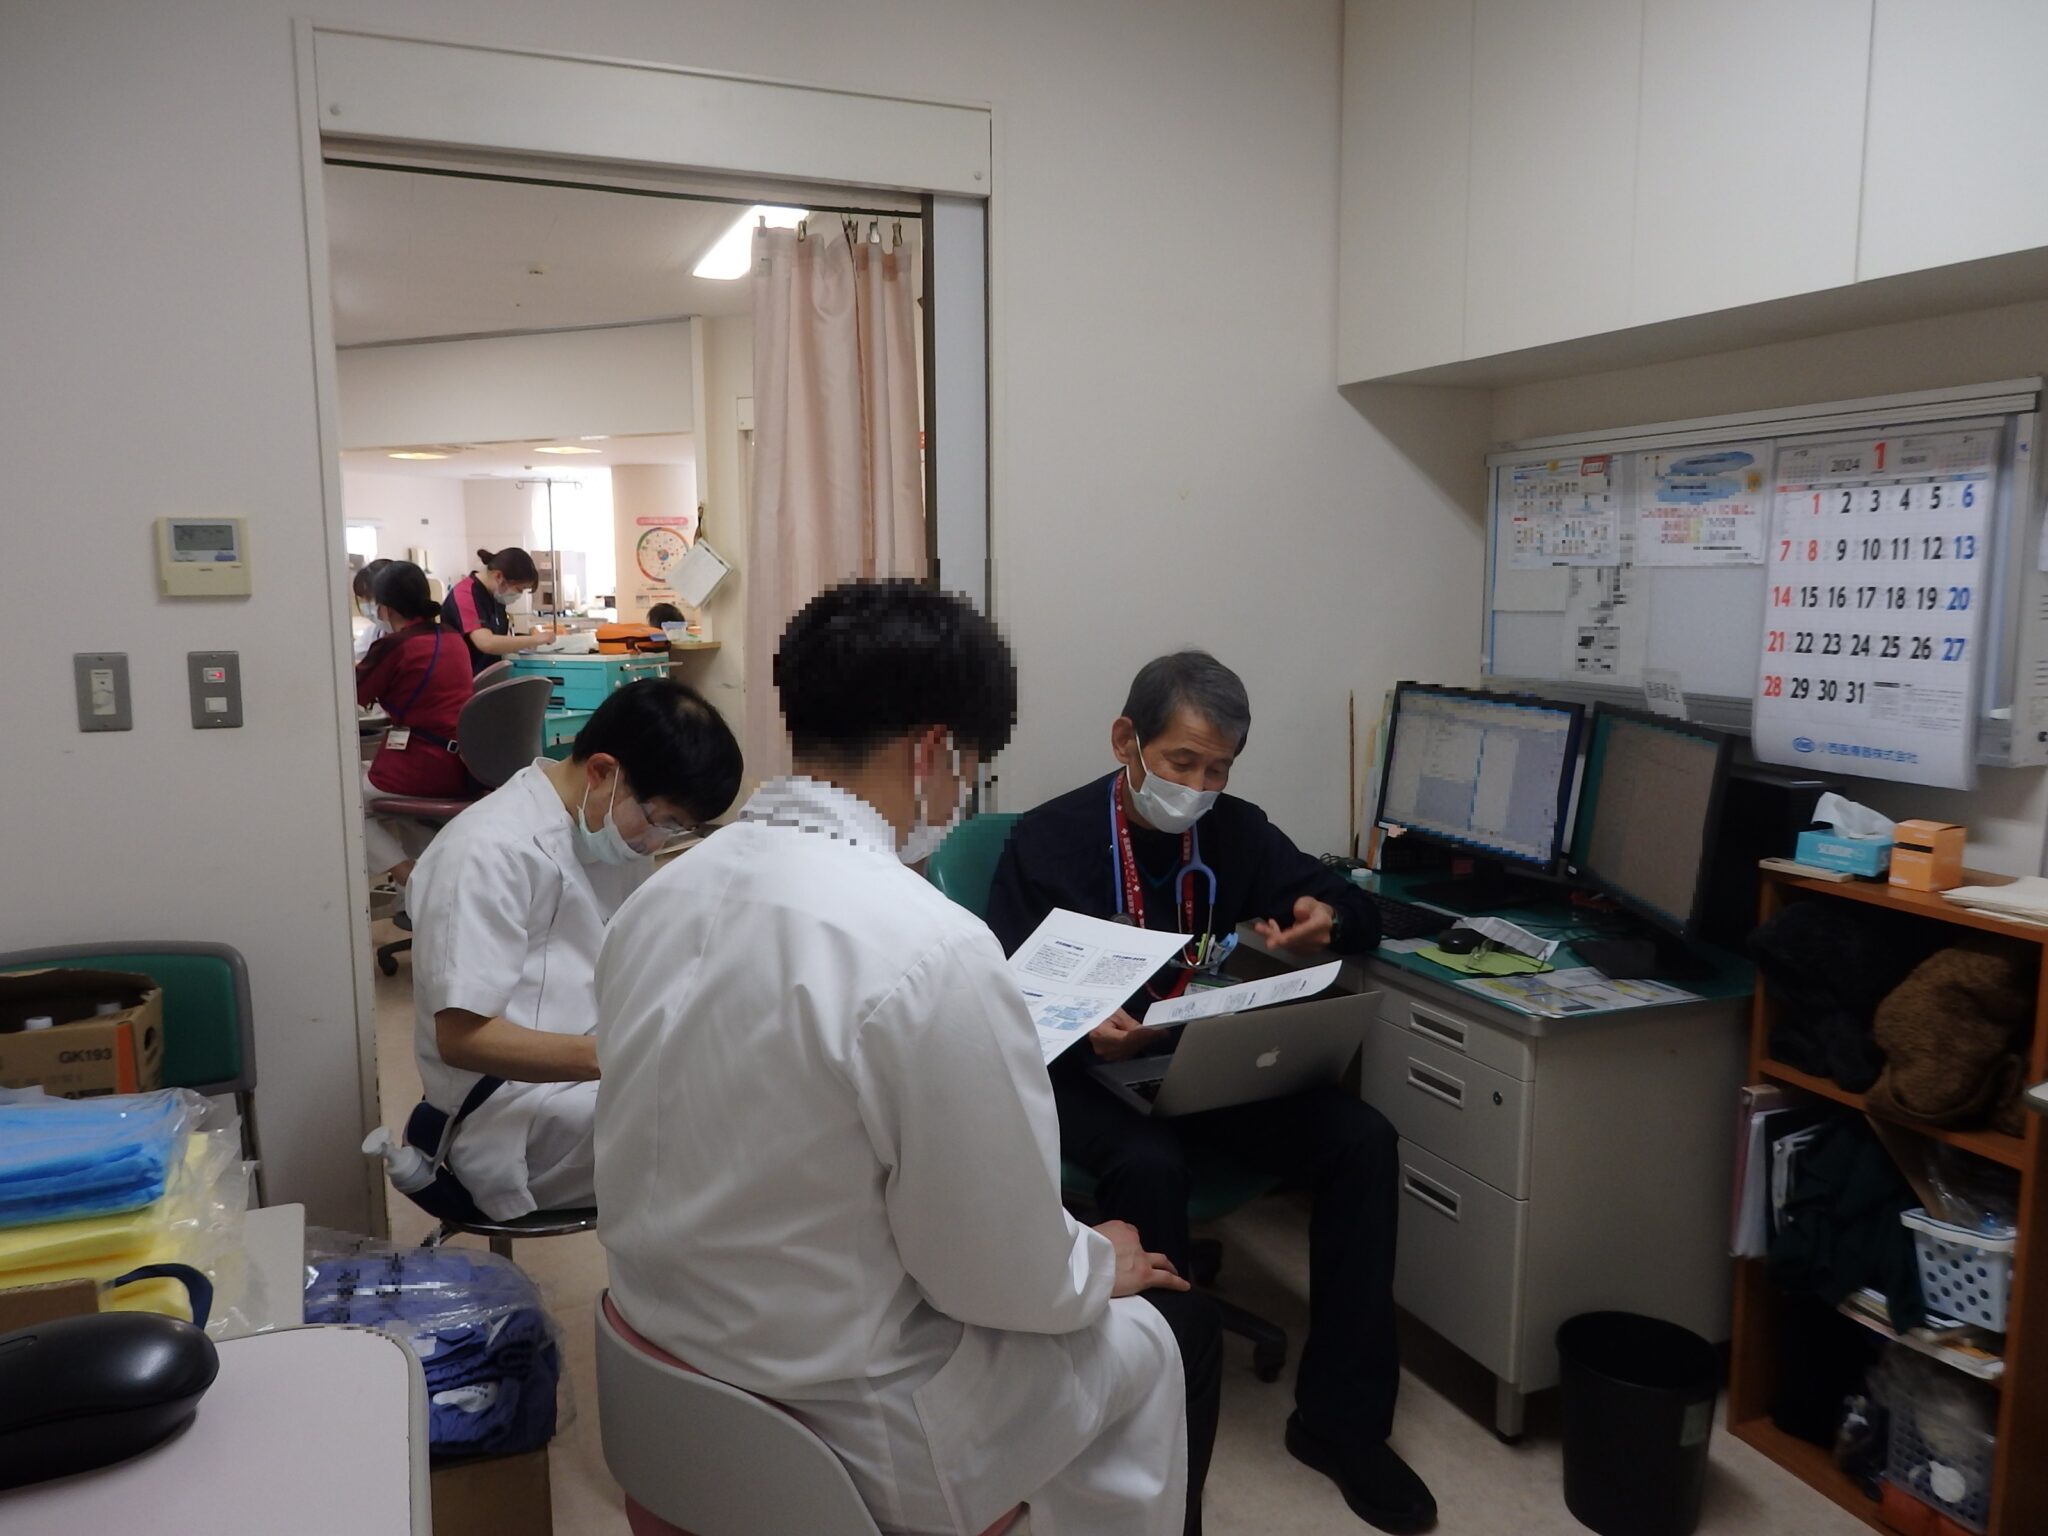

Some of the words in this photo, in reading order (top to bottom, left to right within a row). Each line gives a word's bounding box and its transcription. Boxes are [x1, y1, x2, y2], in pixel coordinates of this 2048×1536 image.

[1830, 458, 1861, 473] 2024
[1874, 441, 1887, 470] 1
[1811, 492, 1823, 515] 1
[1839, 490, 1852, 514] 2
[1869, 489, 1881, 513] 3
[1899, 487, 1911, 511] 4
[1929, 485, 1942, 510] 5
[1961, 482, 1976, 509] 6
[1779, 539, 1792, 562] 7
[1807, 539, 1819, 562] 8
[1836, 538, 1848, 562] 9
[1862, 537, 1882, 561] 10
[1891, 537, 1910, 561] 11
[1922, 536, 1943, 560] 12
[1954, 535, 1976, 560] 13
[1773, 585, 1792, 607] 14
[1800, 586, 1819, 608] 15
[1828, 586, 1847, 609] 16
[1857, 586, 1877, 609] 17
[1886, 586, 1906, 610] 18
[1917, 586, 1938, 611] 19
[1946, 586, 1971, 611] 20
[1767, 630, 1785, 653] 21
[1794, 631, 1814, 654] 22
[1821, 632, 1842, 656] 23
[1849, 633, 1871, 657] 24
[1879, 635, 1901, 659] 25
[1909, 636, 1932, 661] 26
[1941, 637, 1966, 662] 27
[1763, 675, 1783, 698] 28
[1789, 677, 1810, 700] 29
[1817, 679, 1838, 702] 30
[1845, 680, 1865, 704] 31
[58, 1047, 113, 1064] GK193
